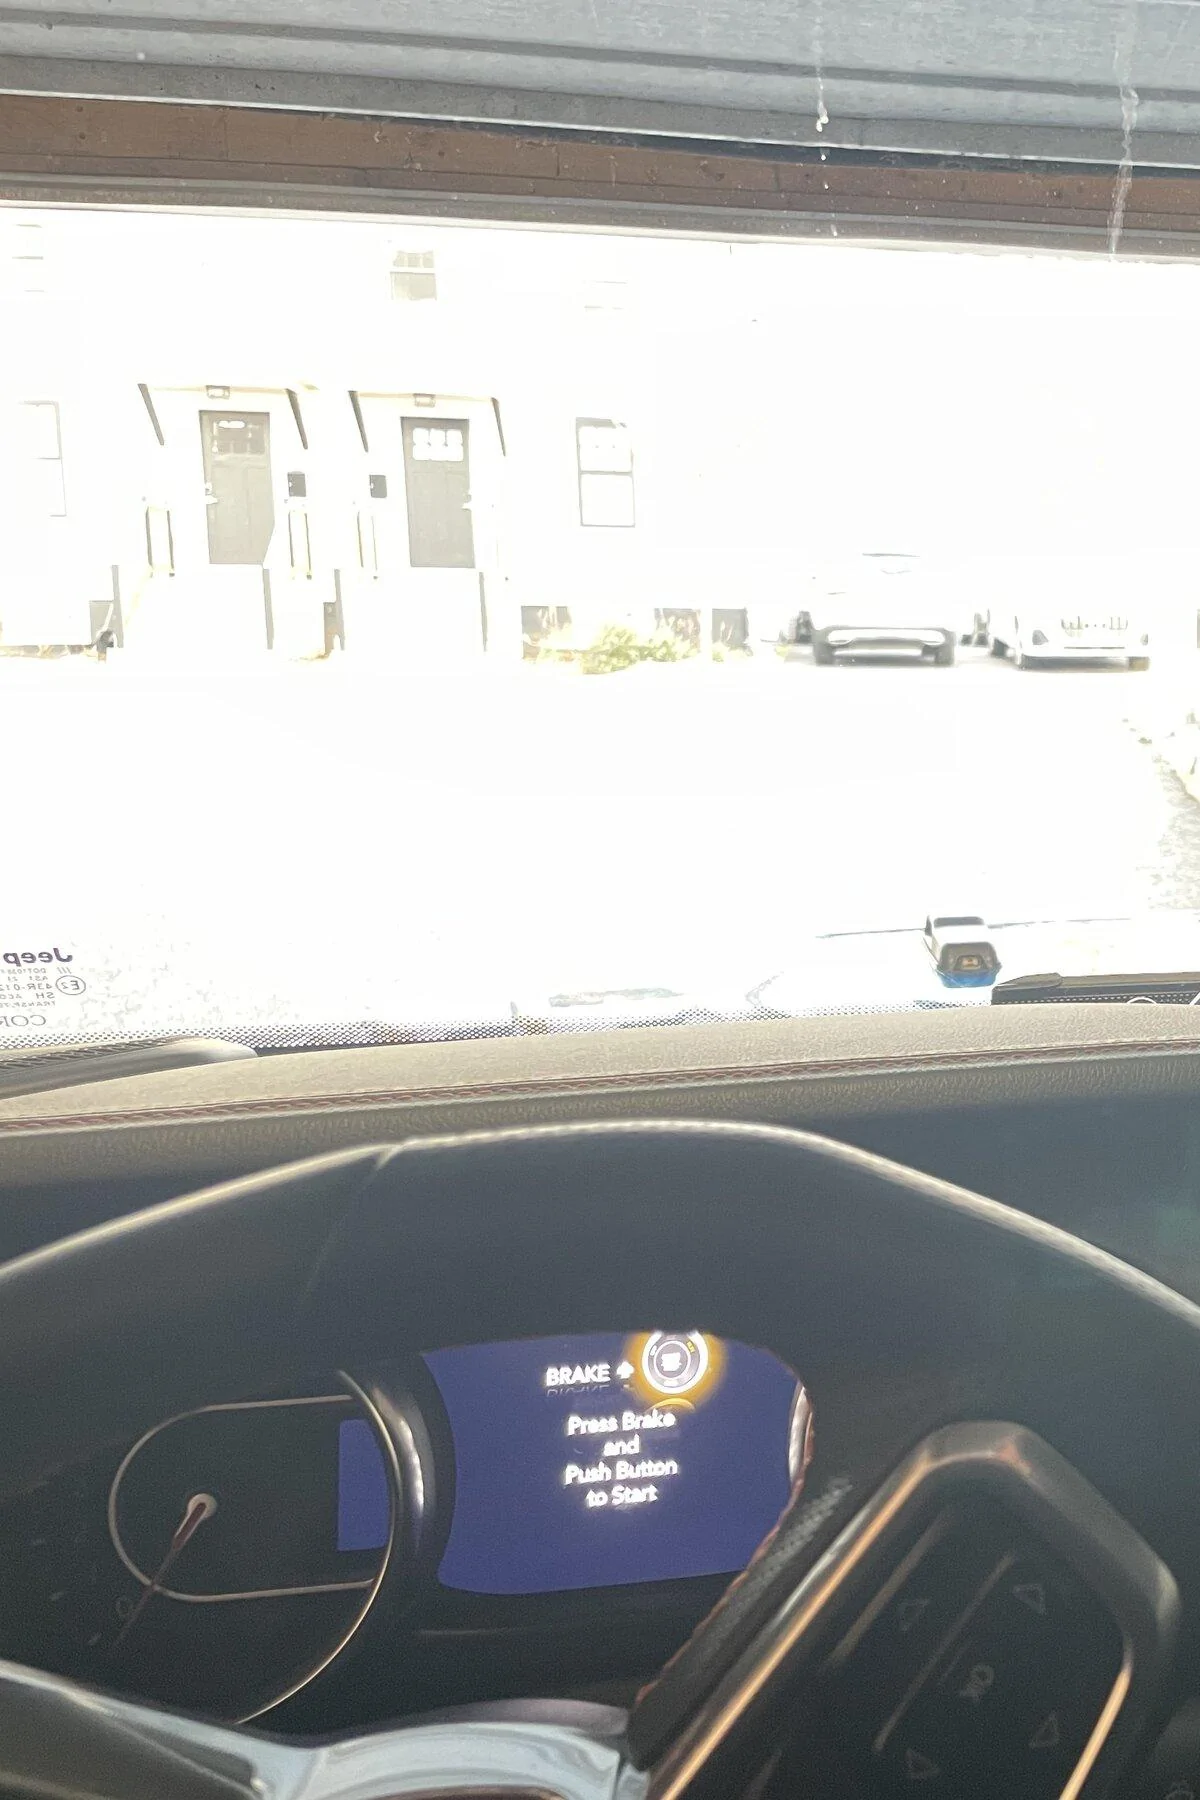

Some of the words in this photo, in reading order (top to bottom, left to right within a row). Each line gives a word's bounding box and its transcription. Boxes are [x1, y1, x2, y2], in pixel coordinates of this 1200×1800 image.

[545, 1362, 611, 1387] BRAKE
[567, 1414, 619, 1436] Press
[622, 1409, 677, 1431] Brake
[602, 1433, 640, 1457] and
[564, 1461, 612, 1486] Push
[615, 1459, 679, 1480] Button
[586, 1489, 609, 1508] to
[611, 1484, 659, 1506] Start
